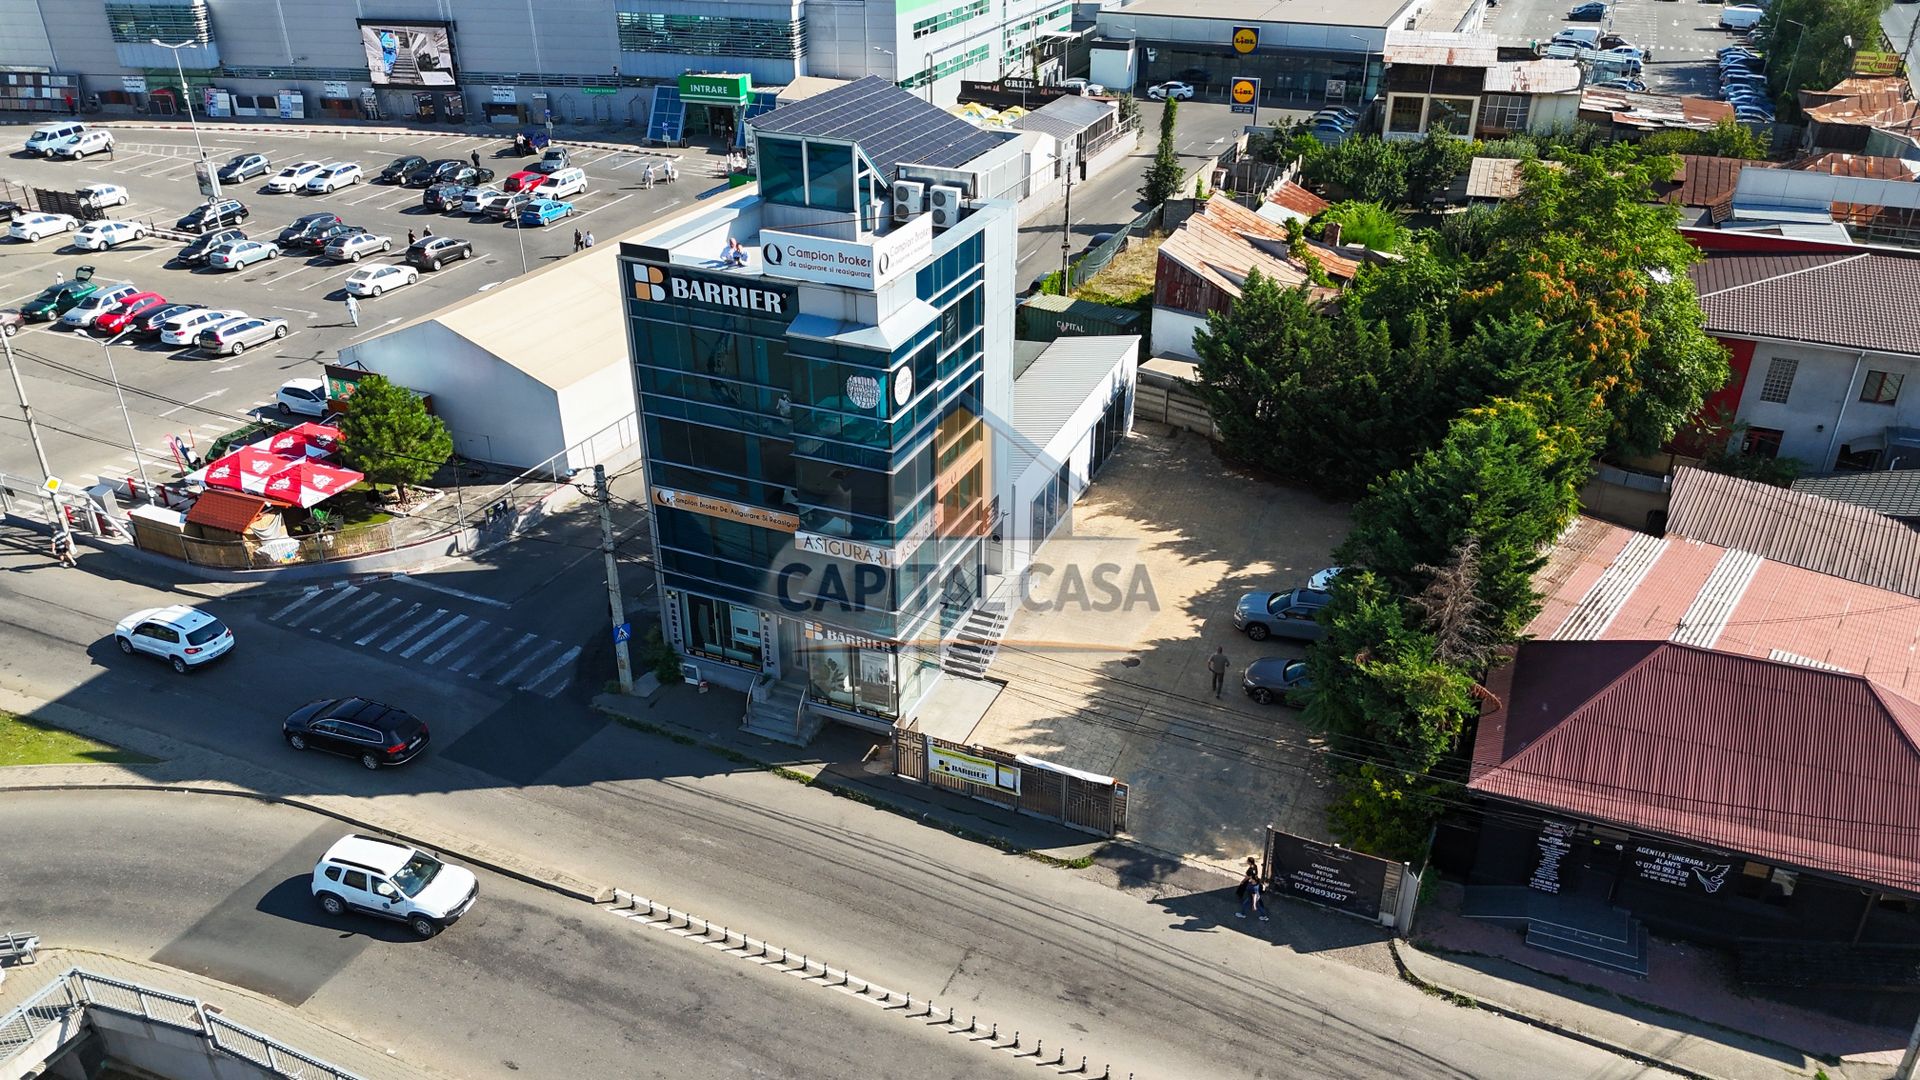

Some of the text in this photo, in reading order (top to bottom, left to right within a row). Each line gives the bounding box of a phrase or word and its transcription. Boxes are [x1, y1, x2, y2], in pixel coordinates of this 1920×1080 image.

[690, 84, 728, 94] INTRARE
[1004, 80, 1035, 89] GRILL
[787, 245, 835, 262] Campion
[838, 252, 872, 268] Broker
[788, 260, 871, 279] de asigurare si reasigurare
[1056, 320, 1086, 332] CAPITAL
[671, 495, 699, 507] Campion
[699, 501, 719, 512] Broker
[719, 506, 729, 514] De
[730, 508, 760, 521] Asigurare
[803, 535, 888, 566] ASIGURARI
[1636, 846, 1704, 867] AGENTIA FUNERARA
[1655, 857, 1682, 869] ALANYS
[1297, 870, 1319, 880] PERDELE
[1311, 862, 1339, 874] CROITORIE
[1294, 882, 1347, 901] 0729893027
